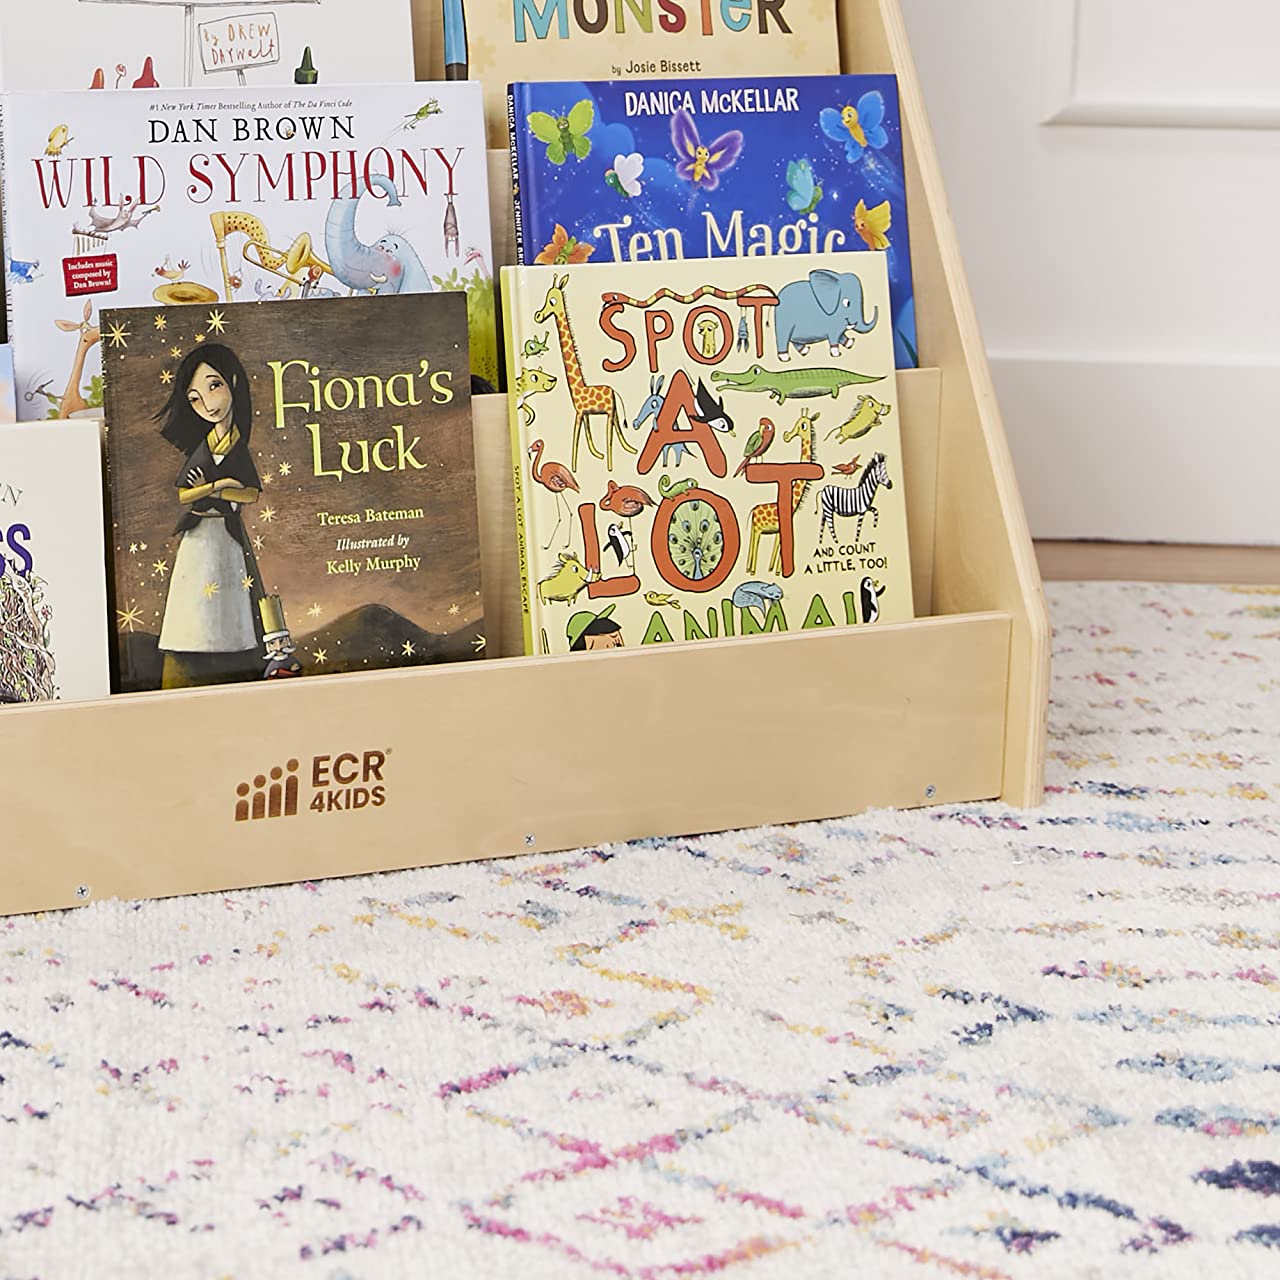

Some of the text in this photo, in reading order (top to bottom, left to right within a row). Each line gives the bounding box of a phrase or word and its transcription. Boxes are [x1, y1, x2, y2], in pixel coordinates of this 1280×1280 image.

[228, 23, 271, 41] DREW
[611, 60, 702, 76] by Josie Bissett
[161, 103, 176, 111] New
[178, 103, 195, 111] York
[197, 102, 217, 110] Times
[218, 102, 256, 112] Bestselling
[257, 101, 282, 110] Author
[283, 101, 292, 109] of
[319, 100, 336, 108] Vinci
[337, 100, 353, 108] Code
[625, 88, 800, 117] DANICA McKELLAR
[148, 115, 355, 143] DAN BROWN
[31, 146, 465, 210] WILD SYMPHONY
[593, 210, 845, 263] Ten Magic
[67, 261, 94, 270] Includes
[72, 270, 102, 280] composed
[599, 295, 780, 373] SPOT
[266, 358, 454, 429] Fiona's
[636, 369, 728, 478] A
[305, 422, 428, 482] Luck
[317, 507, 424, 526] Teresa Bateman
[336, 533, 410, 551] Illustrated by
[578, 461, 825, 600] LOT
[813, 542, 876, 558] AND COUNT
[326, 554, 421, 576] Kelly Murphy
[804, 556, 888, 574] A LITTLE, TOO!
[312, 750, 386, 788] ECR
[310, 785, 386, 812] 4KIDS
